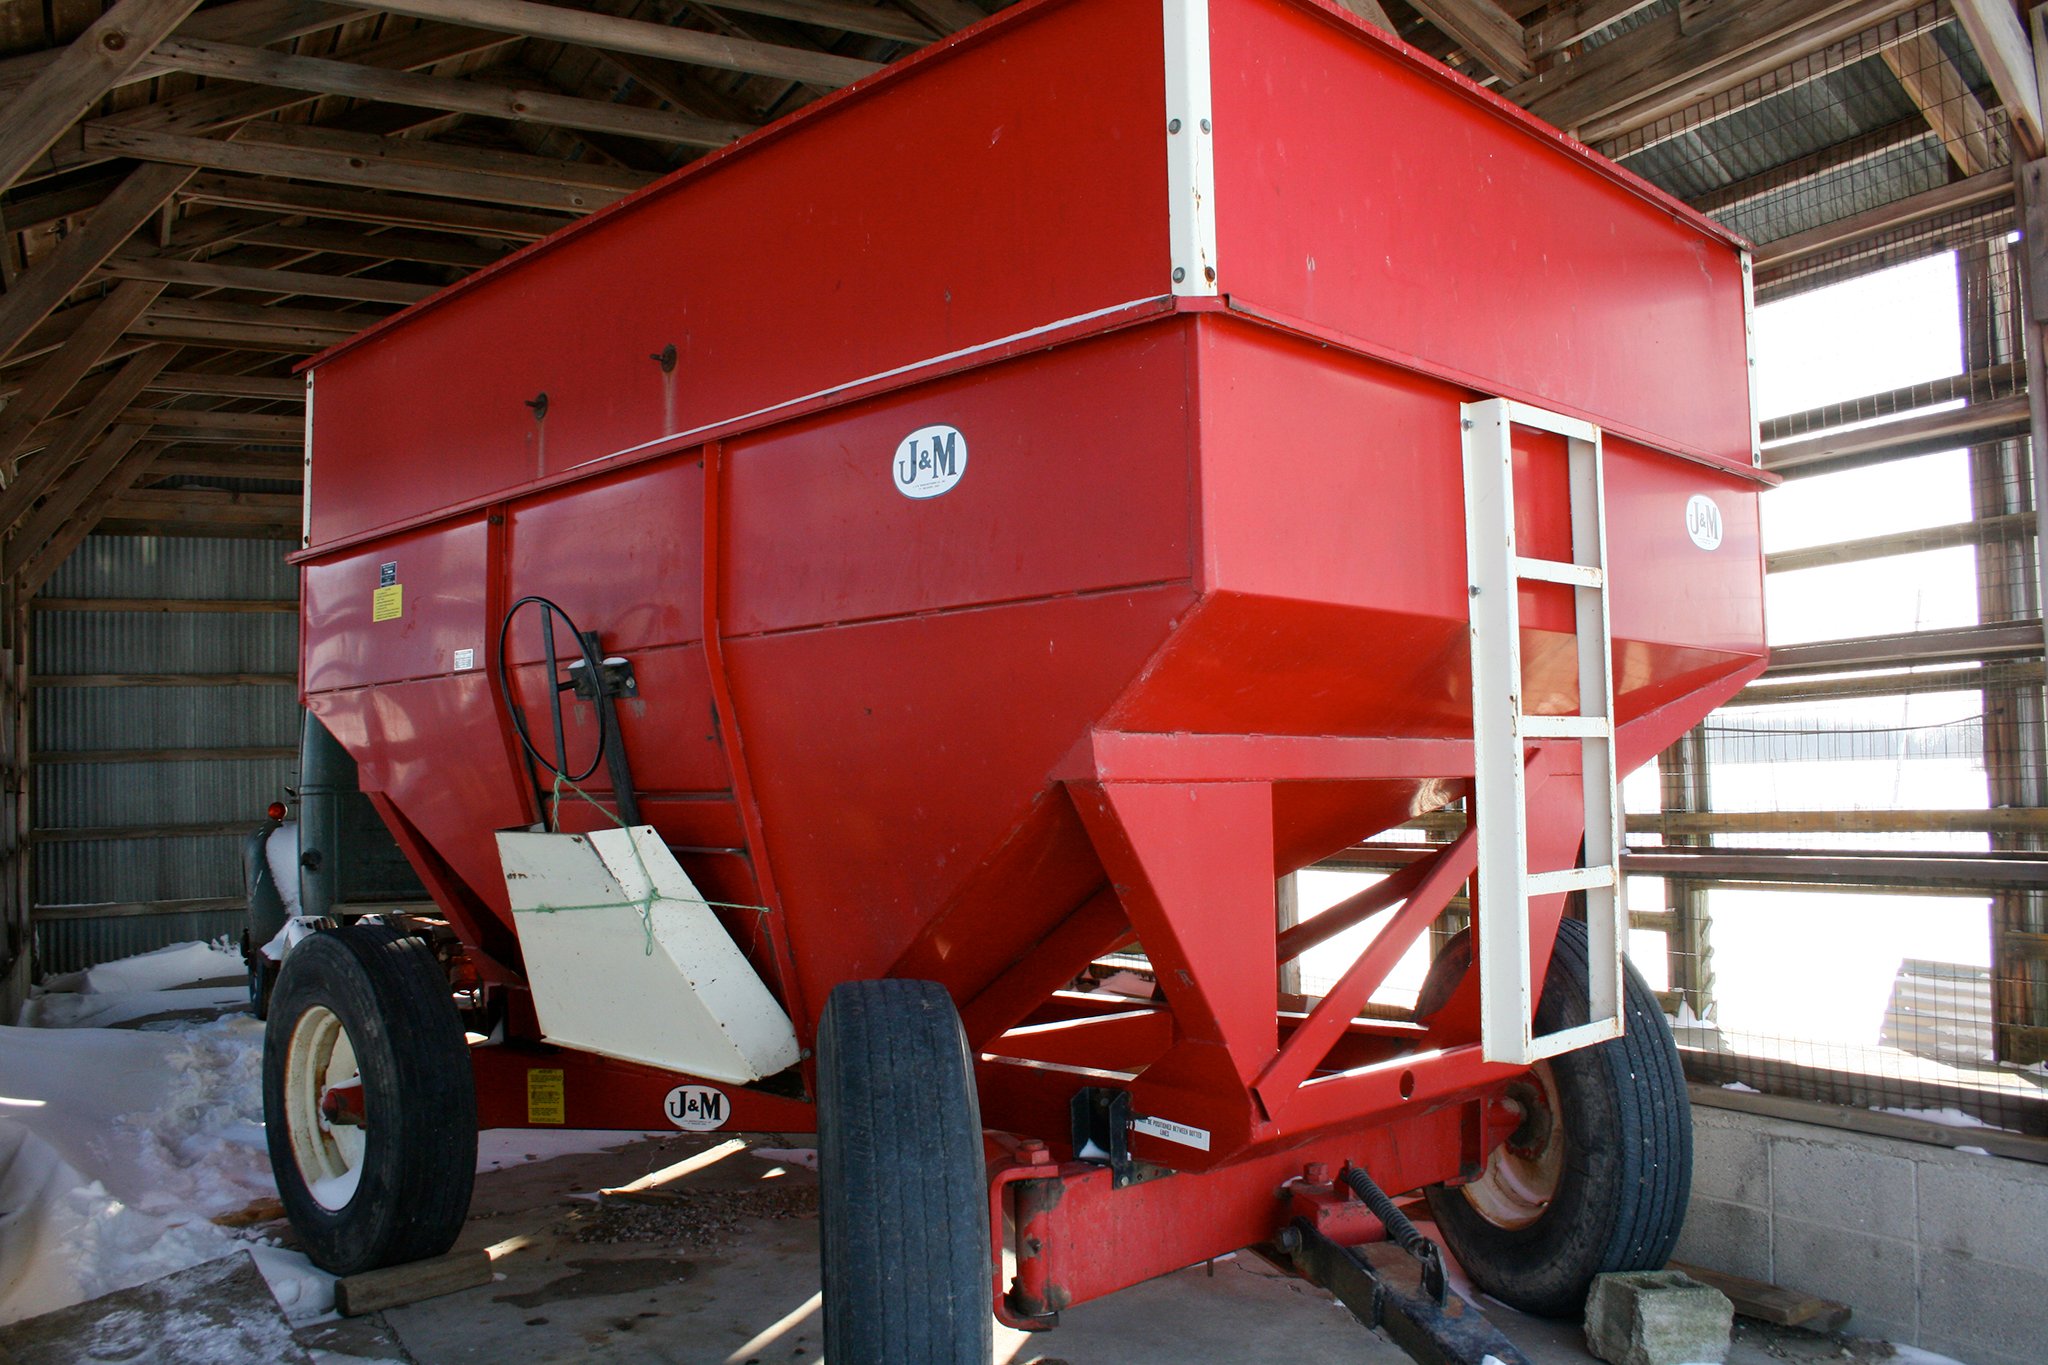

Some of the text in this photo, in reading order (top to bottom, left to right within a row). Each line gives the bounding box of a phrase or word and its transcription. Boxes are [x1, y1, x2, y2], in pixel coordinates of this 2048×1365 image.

[899, 432, 957, 484] J&M
[1689, 501, 1719, 540] J&M
[669, 1091, 721, 1120] J&M
[1160, 1129, 1170, 1137] LINES
[1173, 1124, 1188, 1135] BETWEEN
